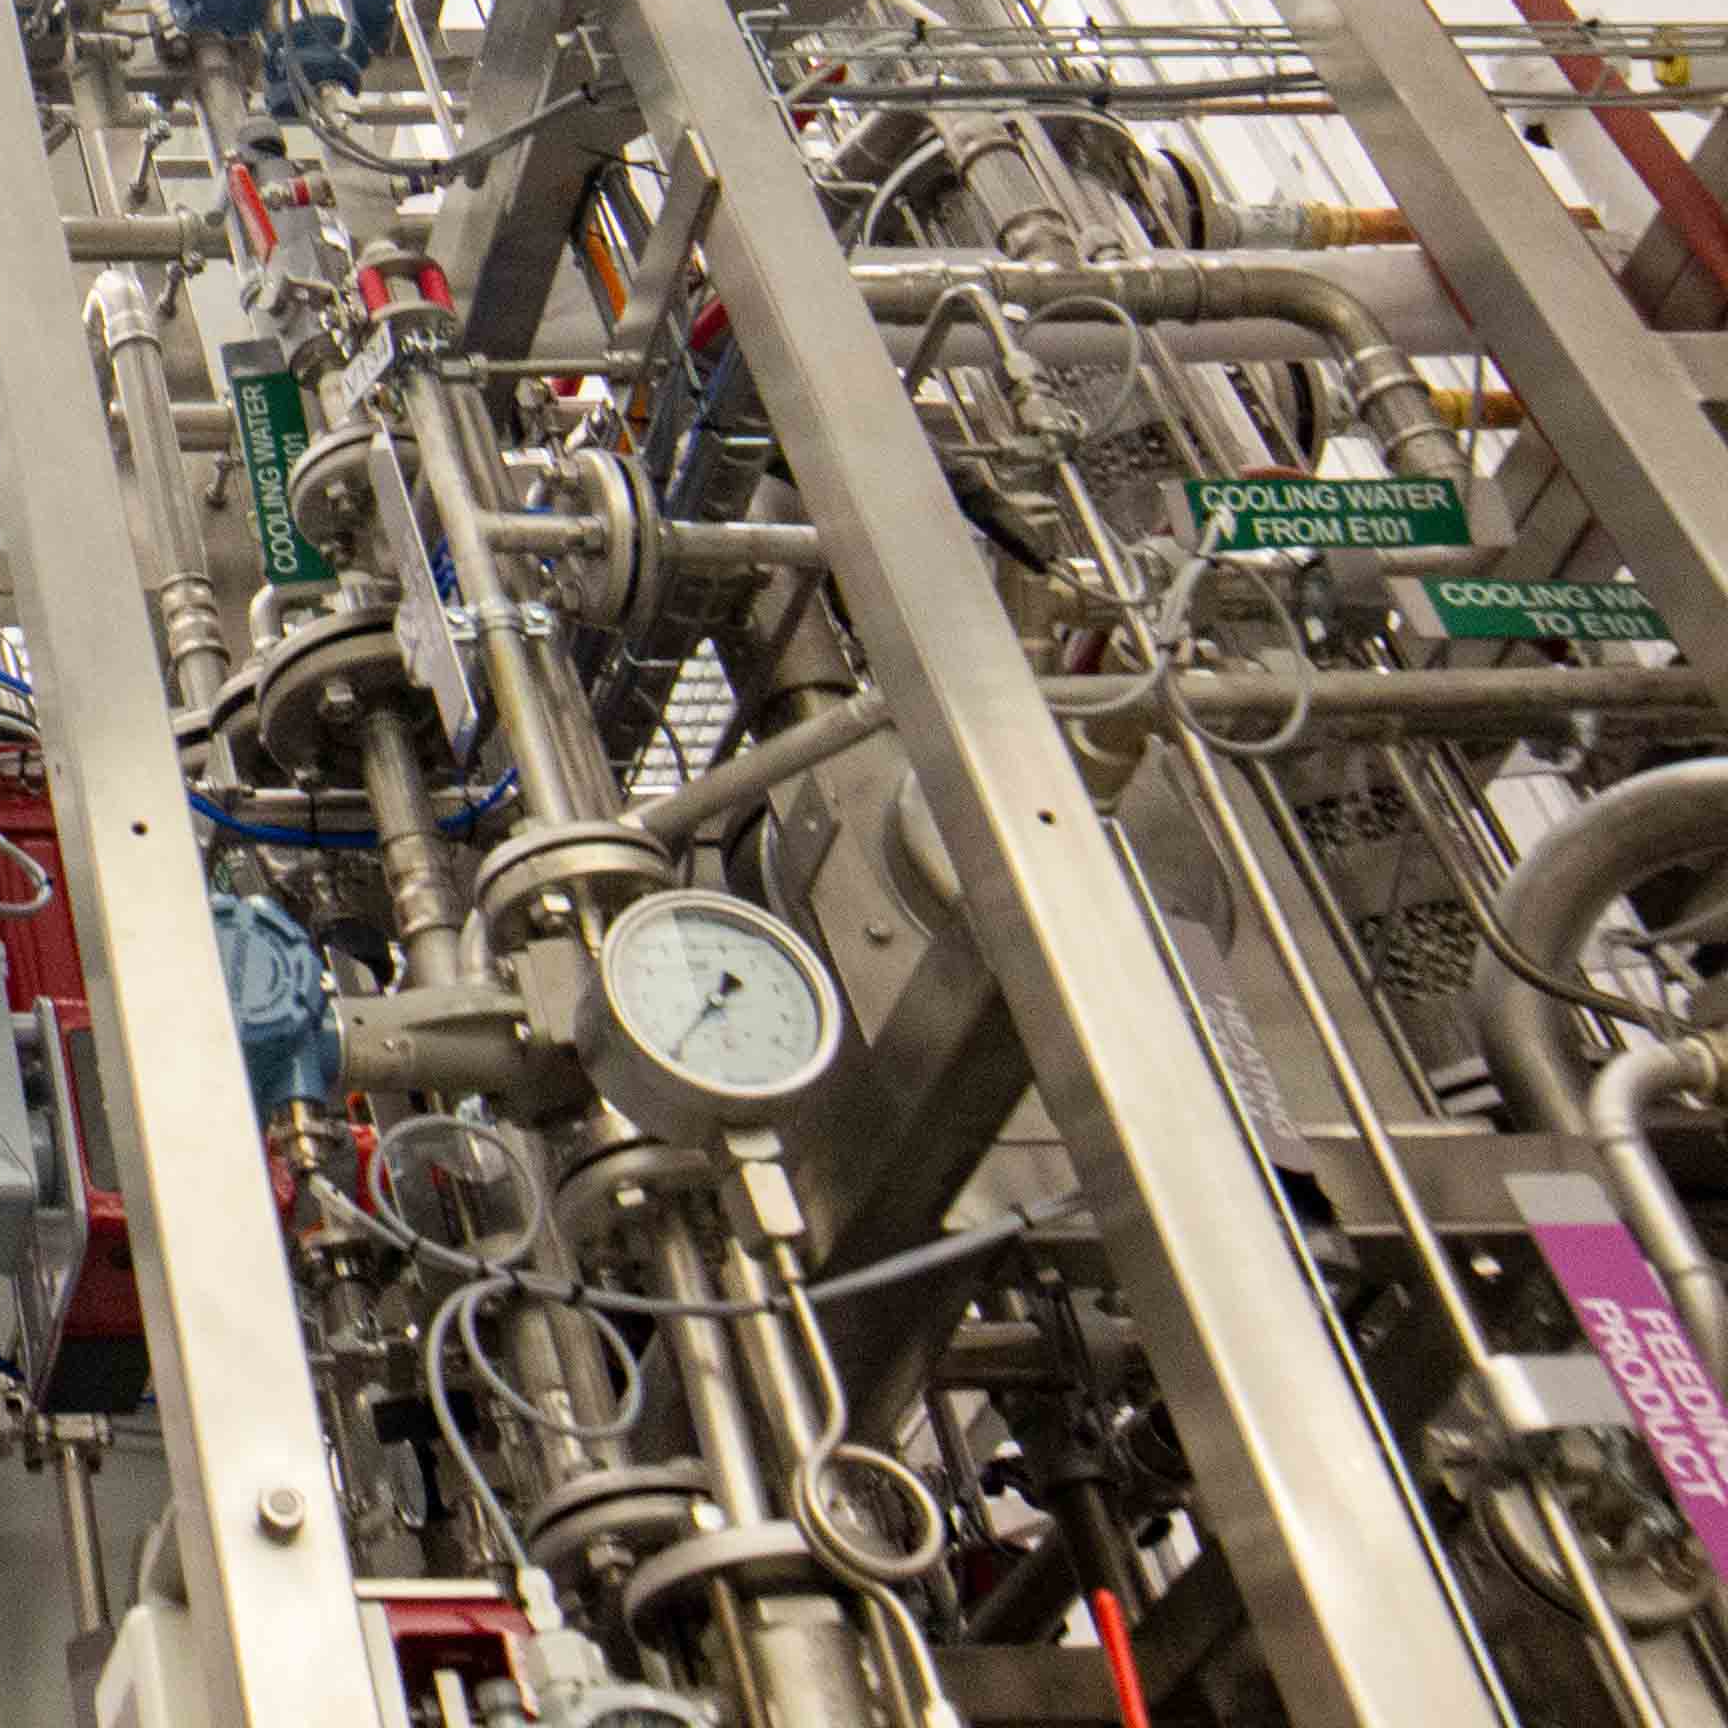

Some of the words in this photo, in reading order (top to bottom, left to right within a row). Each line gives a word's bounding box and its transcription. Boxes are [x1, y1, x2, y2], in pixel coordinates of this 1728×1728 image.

[242, 383, 277, 464] WATER
[258, 466, 298, 573] COOLING
[1201, 483, 1338, 512] COOLING
[1344, 483, 1451, 510] WATER
[1251, 516, 1343, 544] FROM
[1347, 516, 1414, 544] E101
[1440, 582, 1593, 608] COOLING
[1524, 611, 1576, 636] TO
[1577, 613, 1656, 637] E101
[1215, 993, 1302, 1141] HEATING
[1579, 1296, 1728, 1507] PRODUCT
